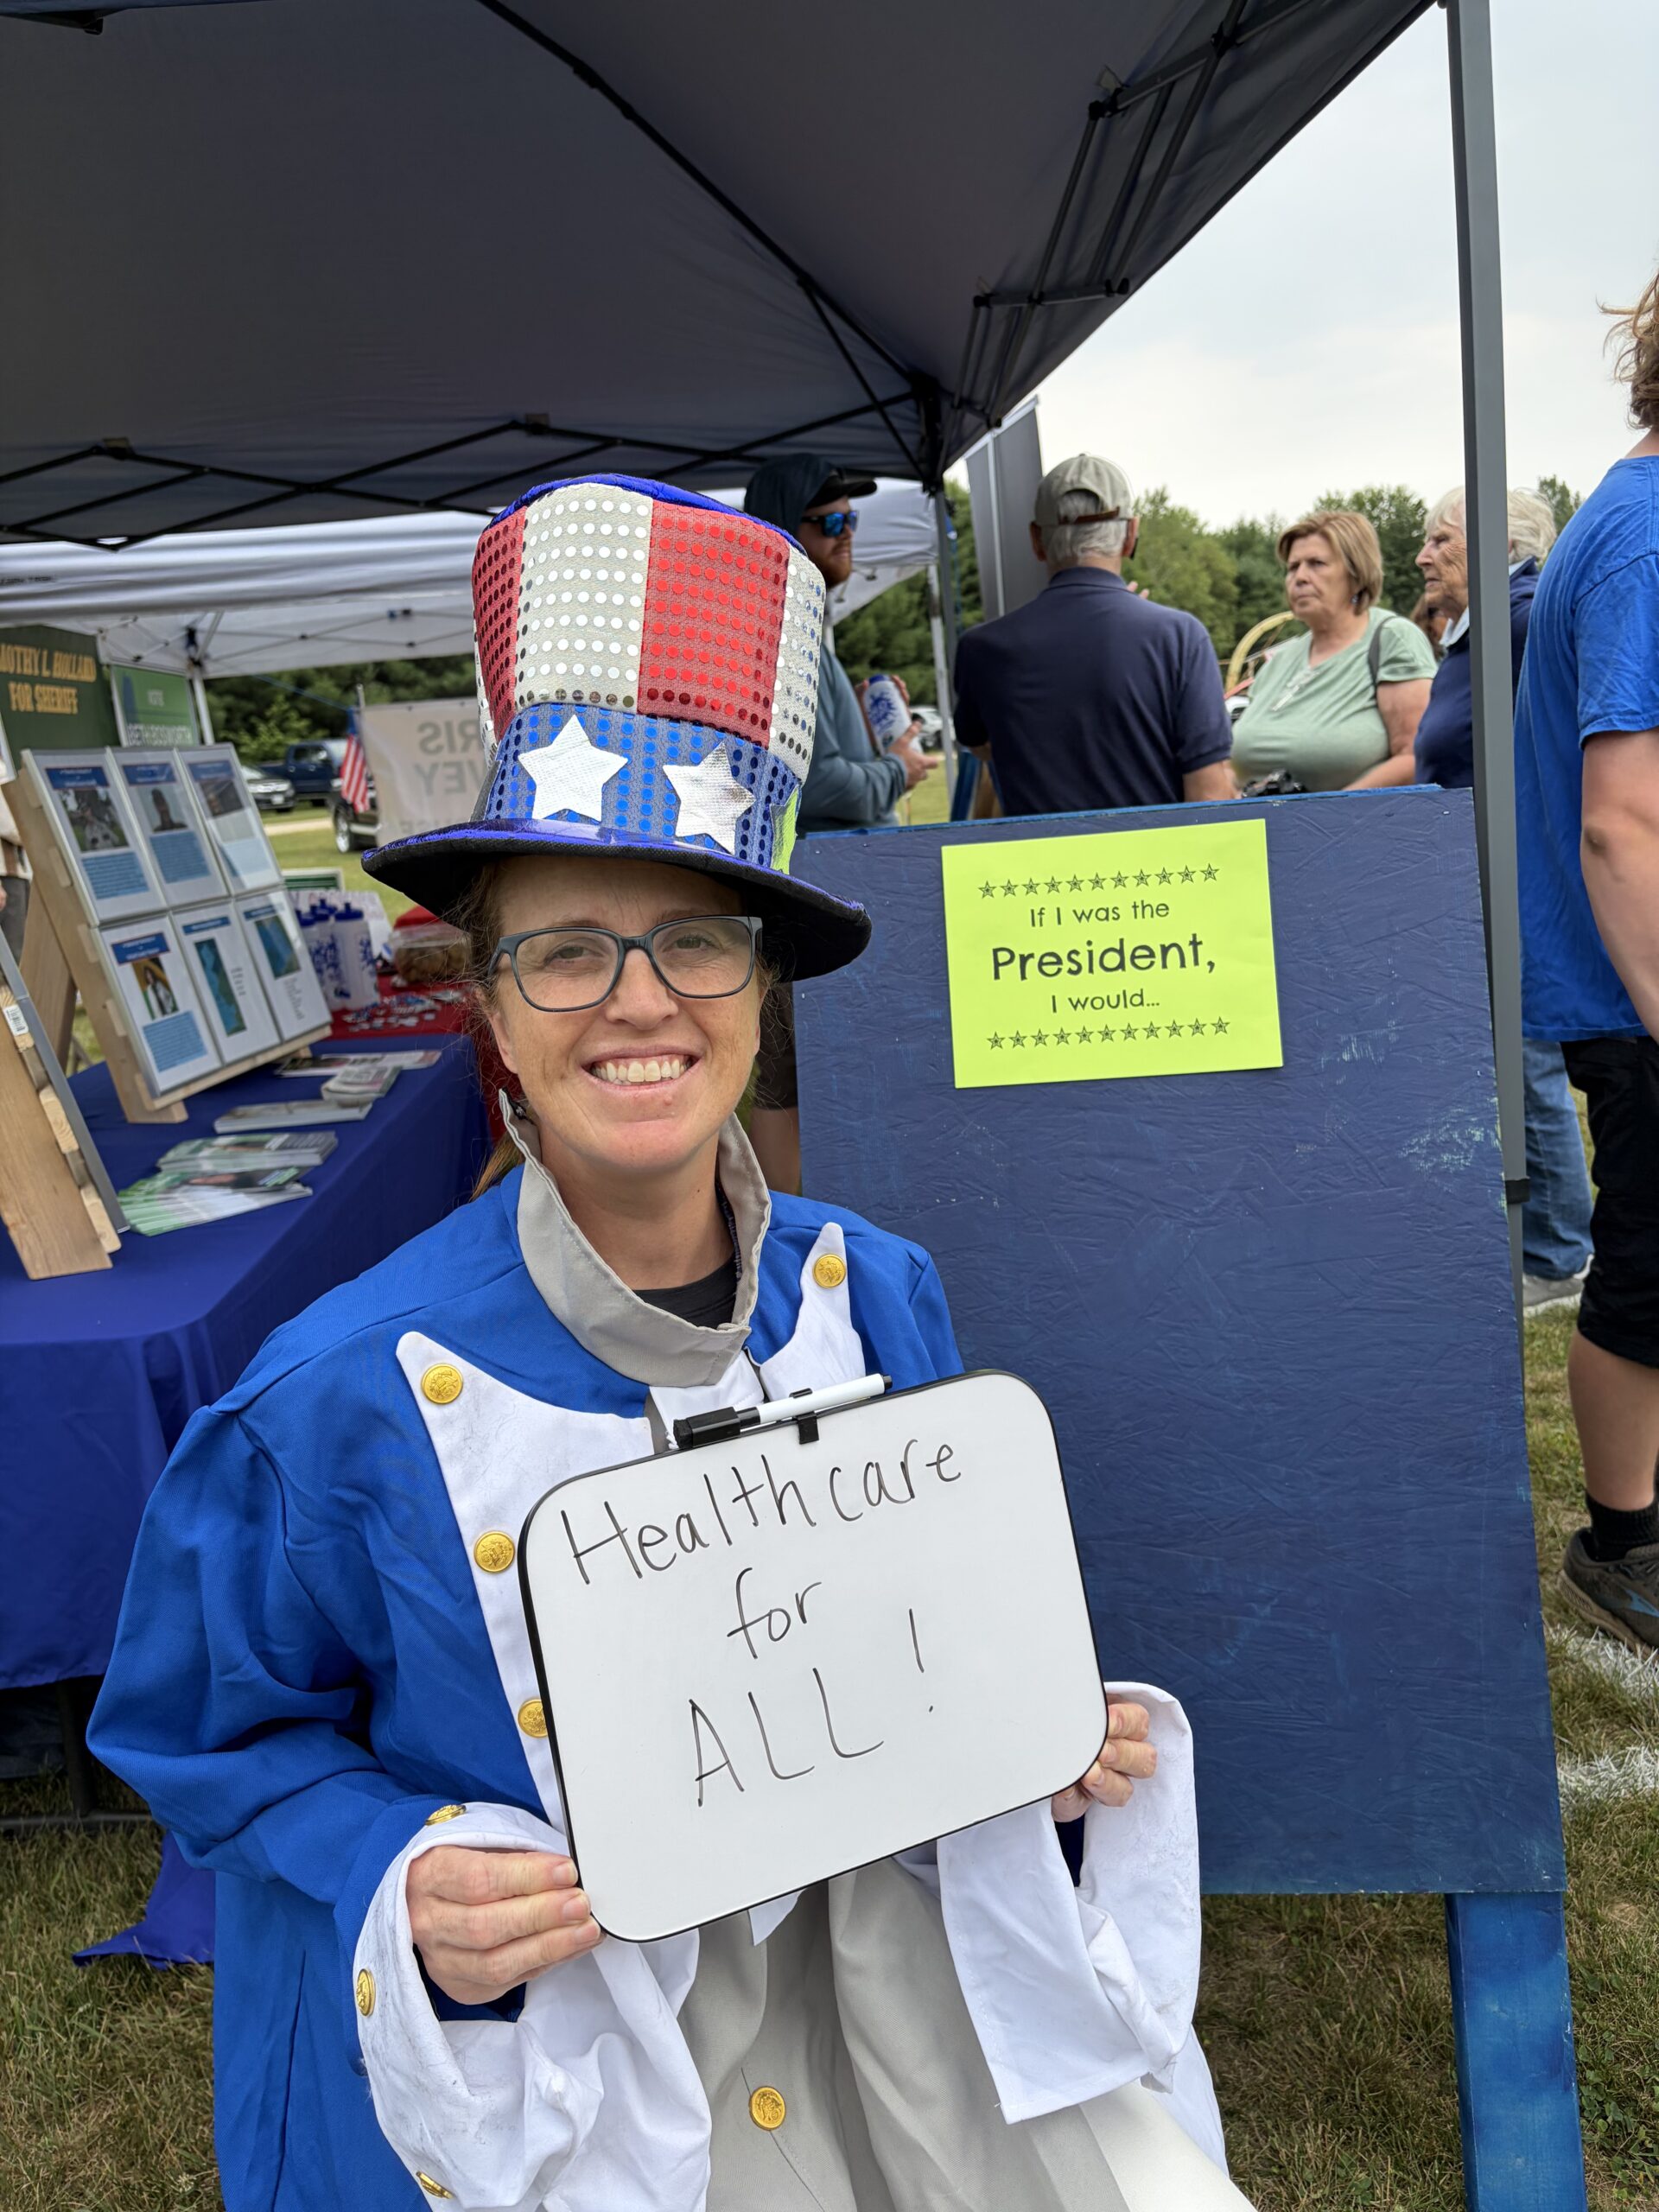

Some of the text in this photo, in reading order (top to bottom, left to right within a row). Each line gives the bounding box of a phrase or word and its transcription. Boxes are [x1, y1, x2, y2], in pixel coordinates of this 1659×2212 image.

[9, 681, 78, 715] FOR SHERIFF
[1030, 899, 1170, 927] If I was the
[992, 933, 1216, 982] President,
[1052, 988, 1160, 1014] I would...
[727, 1567, 822, 1659] for
